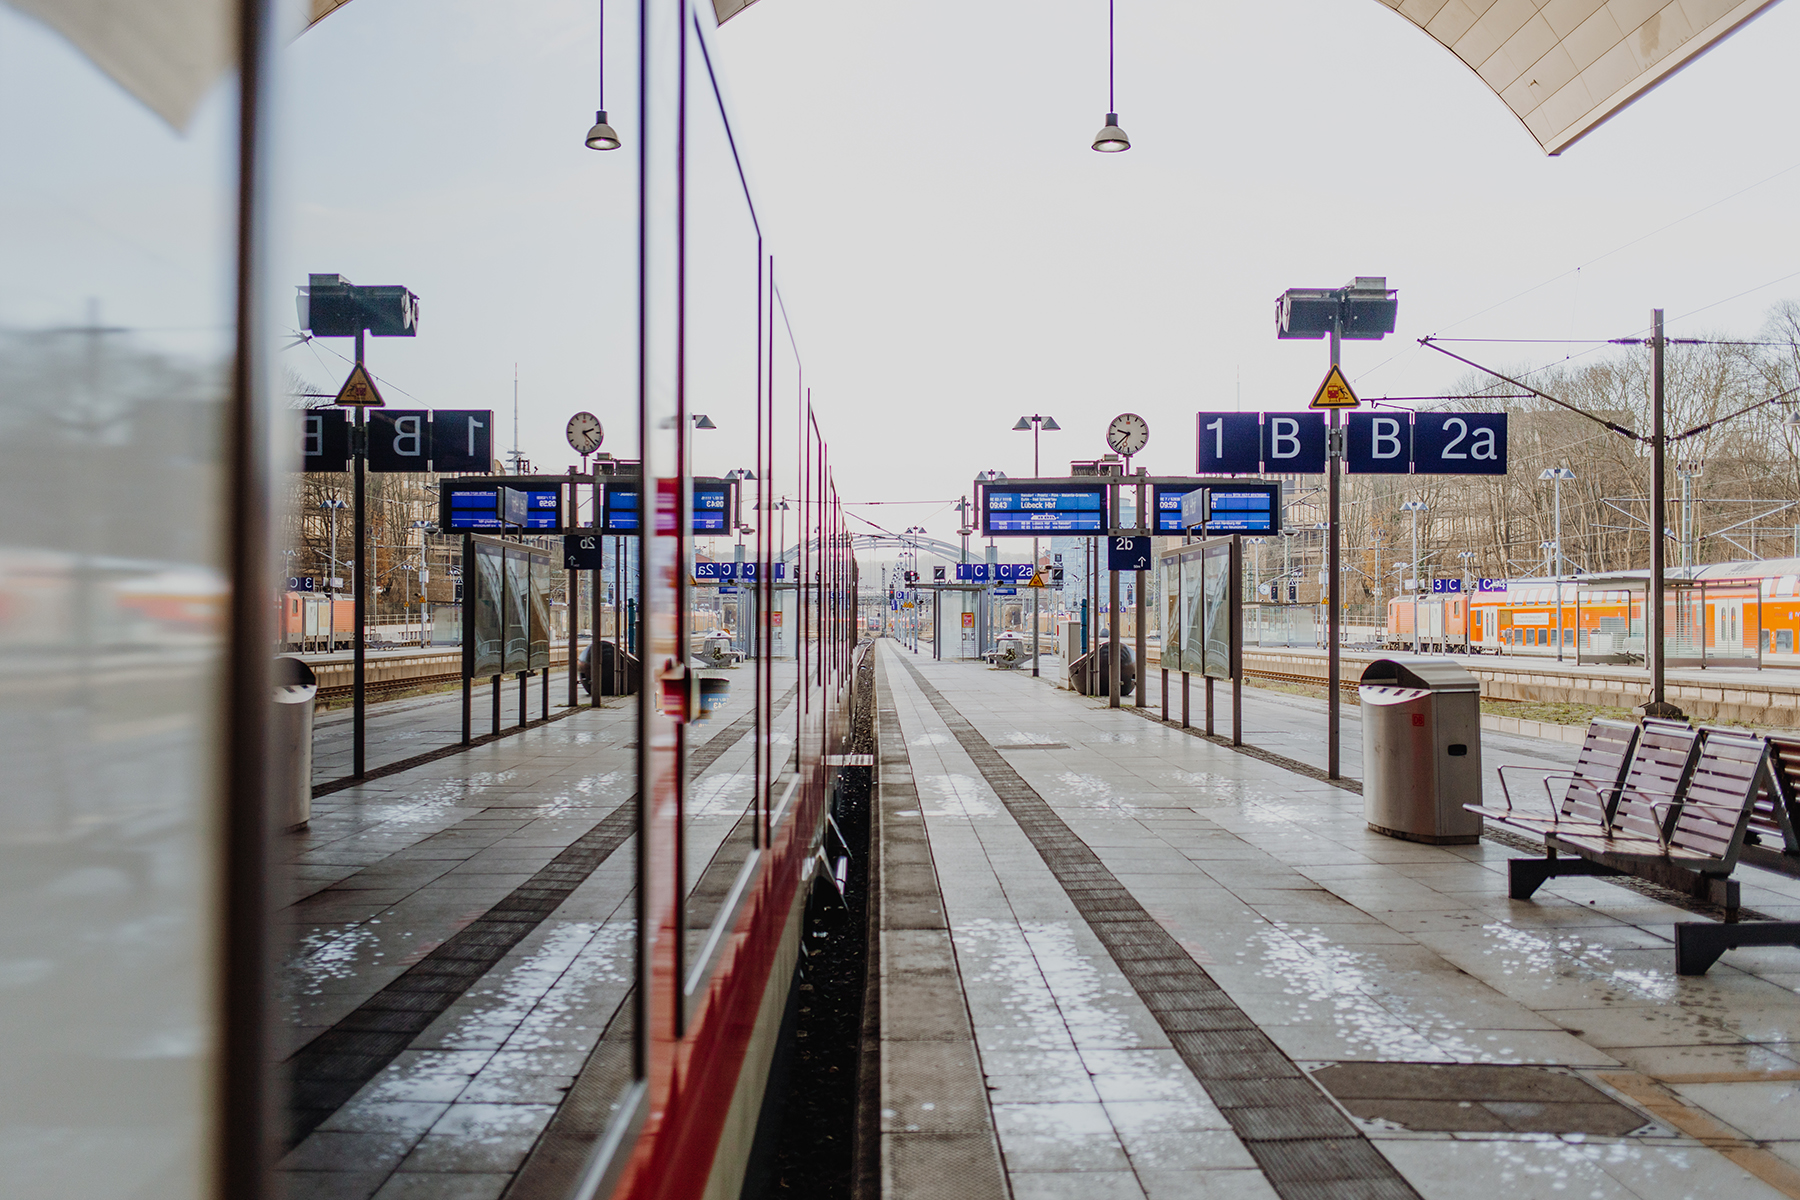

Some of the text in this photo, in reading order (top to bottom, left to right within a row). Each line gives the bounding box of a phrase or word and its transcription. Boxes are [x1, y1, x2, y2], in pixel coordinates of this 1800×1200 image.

[1206, 417, 1301, 458] 1 B
[1372, 417, 1497, 459] B 2a
[1116, 537, 1133, 550] 2b
[958, 565, 983, 577] 1 C
[1000, 565, 1034, 577] C 2a
[1434, 579, 1457, 590] 3 C
[1482, 579, 1491, 590] C
[1771, 631, 1774, 640] 2
[1413, 715, 1423, 725] DB
